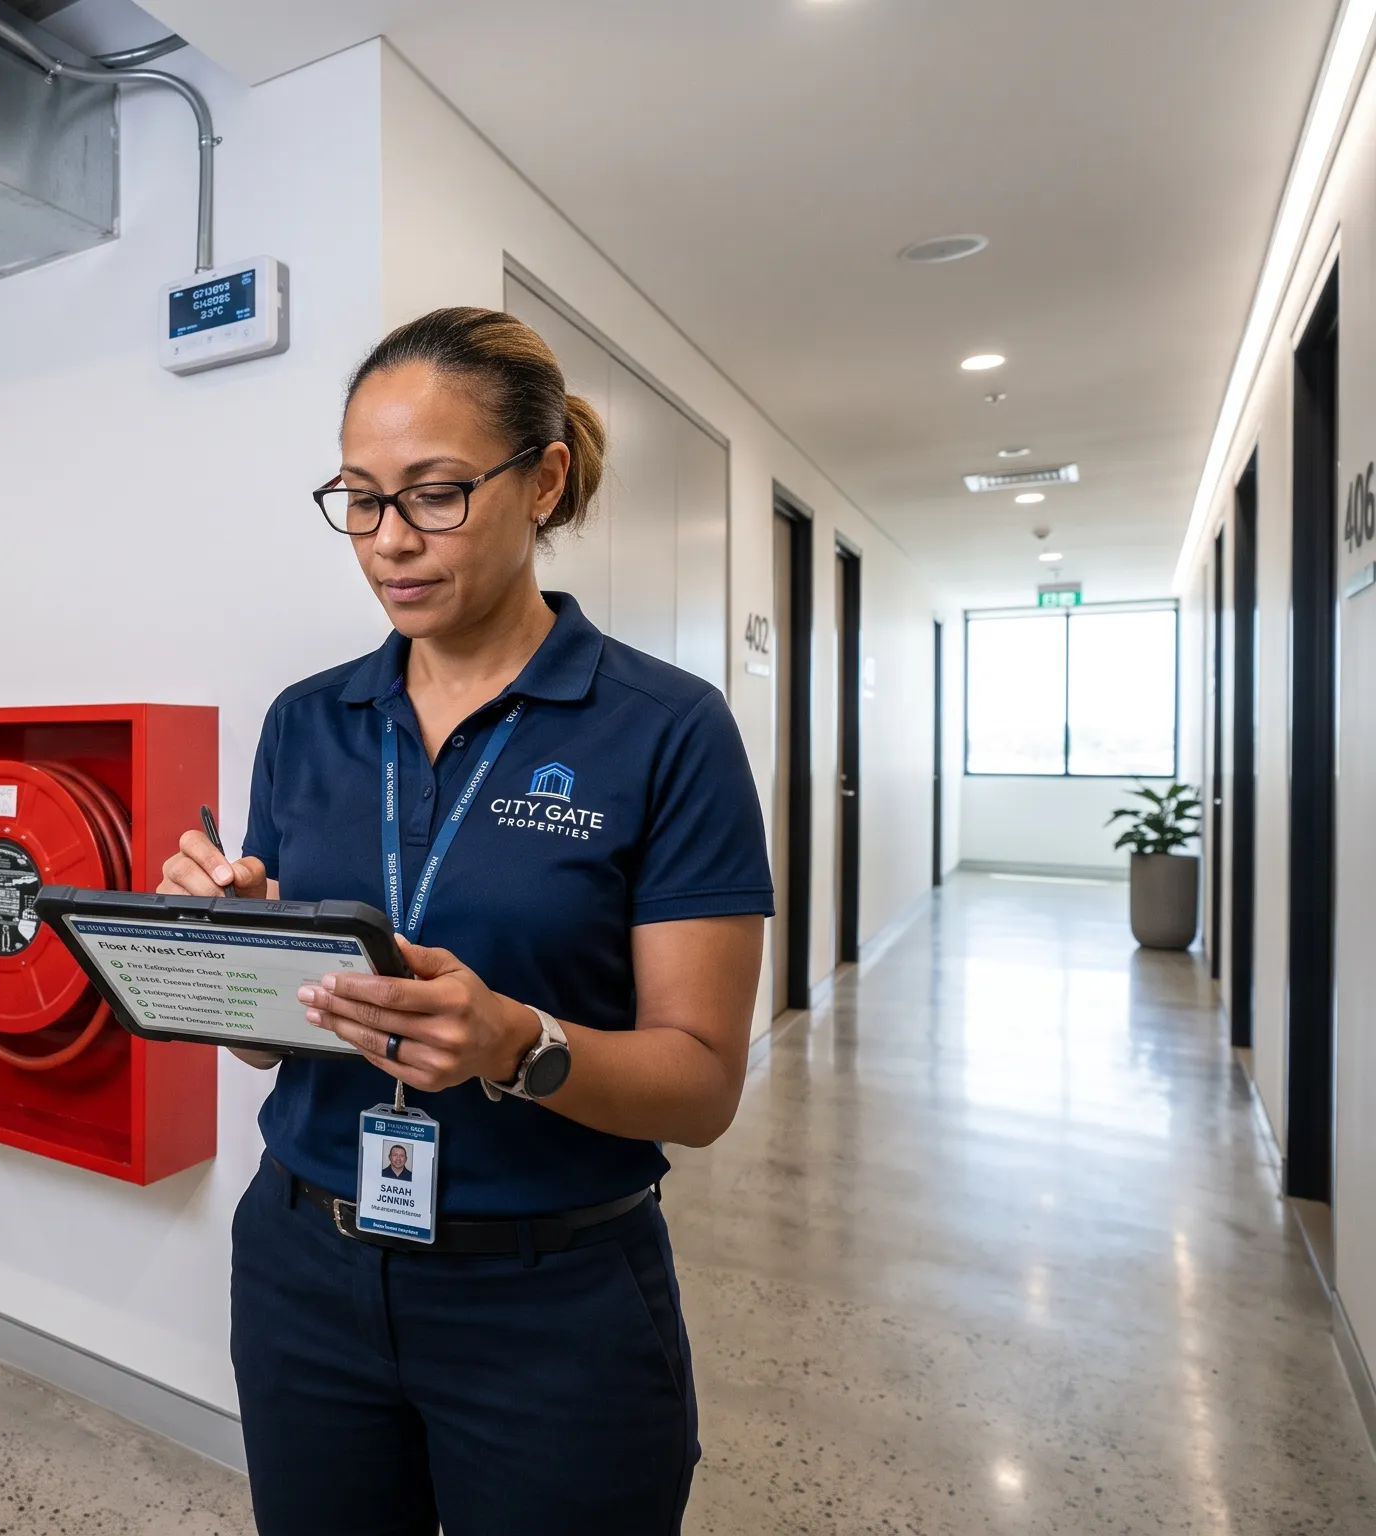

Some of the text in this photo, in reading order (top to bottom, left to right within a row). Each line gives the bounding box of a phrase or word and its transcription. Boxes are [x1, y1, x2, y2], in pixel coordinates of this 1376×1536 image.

[1344, 461, 1374, 554] 406
[745, 612, 769, 654] 402
[490, 799, 604, 829] CITY GATE
[498, 817, 589, 840] PROPERTIES
[143, 945, 176, 956] West
[177, 948, 225, 960] Corridor
[380, 1184, 412, 1196] SARAH
